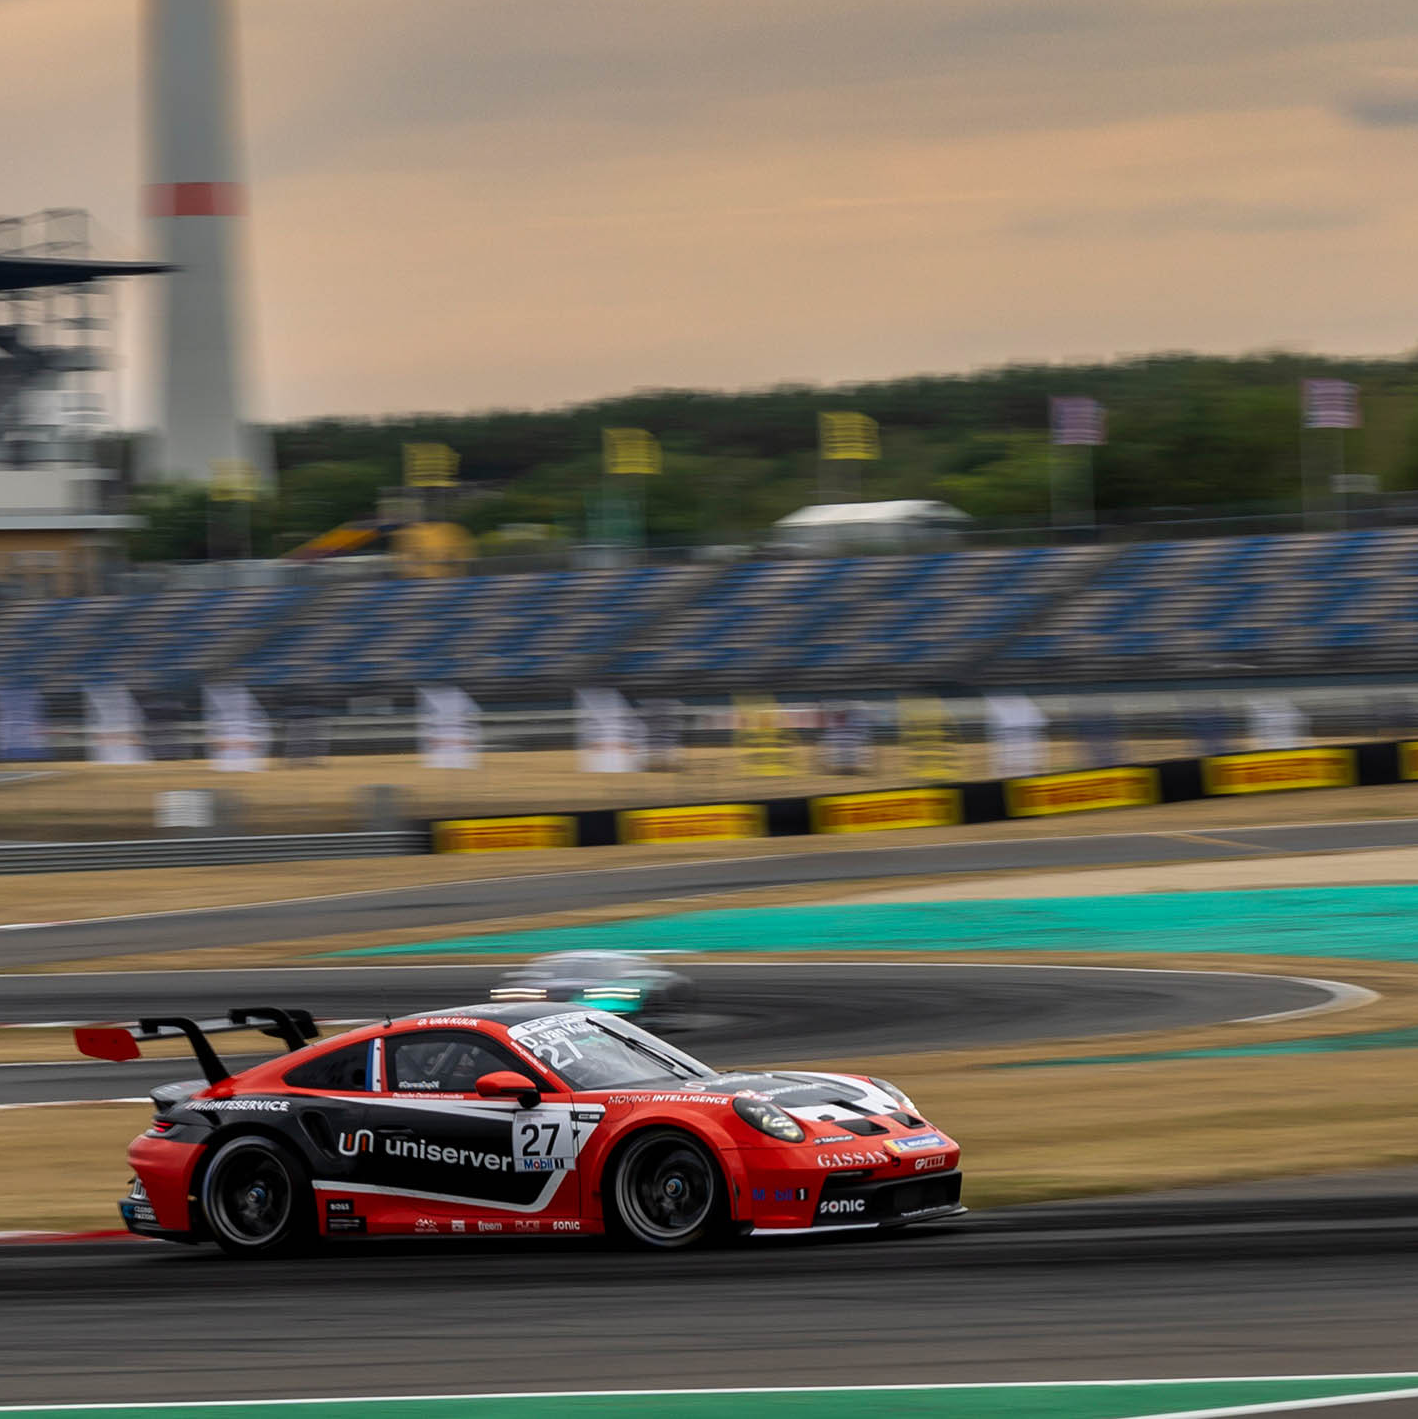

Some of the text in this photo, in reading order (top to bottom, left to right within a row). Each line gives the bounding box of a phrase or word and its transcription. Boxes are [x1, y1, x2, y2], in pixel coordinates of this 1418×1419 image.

[533, 1037, 583, 1070] 27
[607, 1095, 652, 1105] MOVING
[652, 1094, 729, 1105] INTELLIGENCE
[521, 1123, 560, 1157] 27
[385, 1138, 512, 1172] uniserver
[524, 1158, 553, 1170] Mobil
[816, 1150, 889, 1168] GASSAN
[752, 1188, 793, 1201] Mbil
